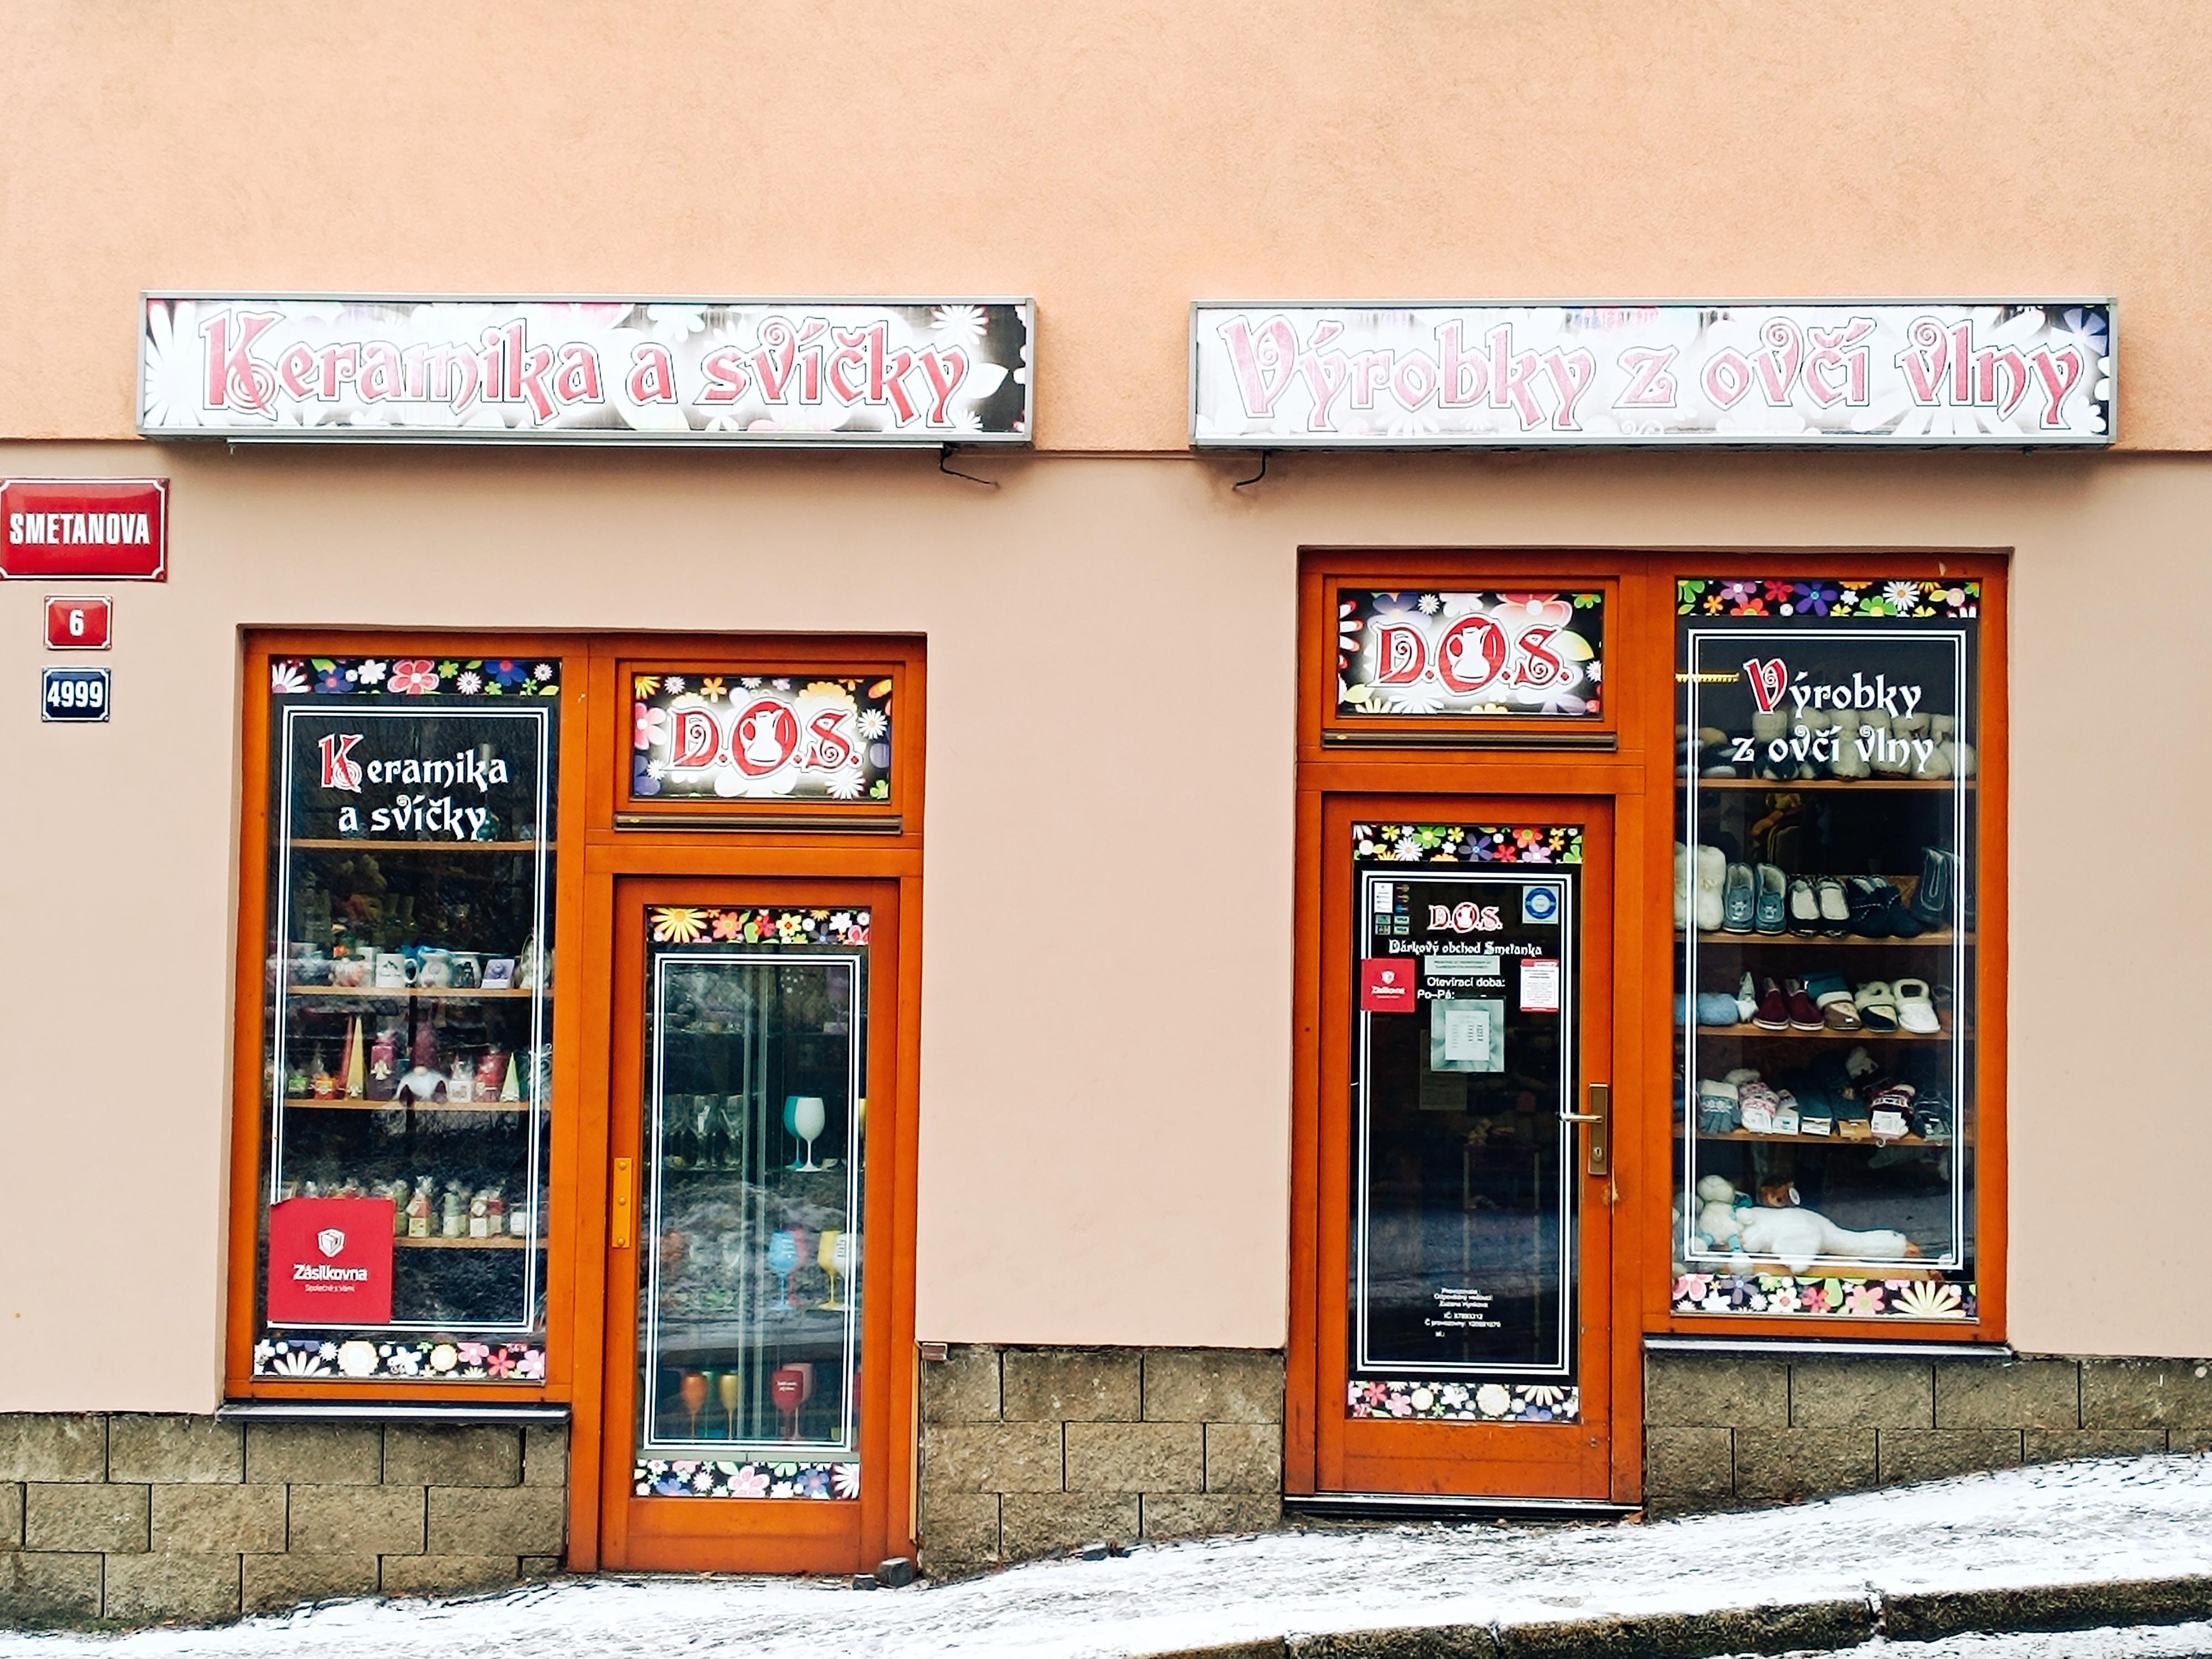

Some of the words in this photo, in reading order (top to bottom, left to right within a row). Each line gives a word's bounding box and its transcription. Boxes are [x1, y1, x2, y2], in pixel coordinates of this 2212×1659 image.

[201, 311, 603, 424] Keramika
[628, 345, 675, 404] a
[697, 317, 968, 426] svíčky
[1219, 316, 1594, 430] Výrobky
[1615, 347, 1676, 406] z
[1703, 318, 1874, 408] ovčí
[1897, 318, 2082, 427] vlny
[10, 513, 150, 545] SMETANOVA
[69, 609, 85, 637] 6
[1368, 614, 1572, 695] D.O.S.
[47, 680, 103, 707] 4999
[1743, 658, 1922, 719] Výrobky
[666, 697, 863, 779] D.O.S.
[1731, 737, 1755, 762] z
[1768, 725, 1843, 763] ovčí
[1854, 725, 1934, 773] vlny
[318, 733, 508, 793] Keramika
[338, 806, 359, 832] a
[371, 794, 487, 842] svíčky
[1427, 902, 1503, 933] D.O.S.
[1389, 939, 1439, 956] Dárkový
[1442, 941, 1480, 954] obchod
[1484, 941, 1542, 957] Smetanka
[1476, 977, 1505, 987] doba:
[293, 1264, 368, 1281] Zásilkovna
